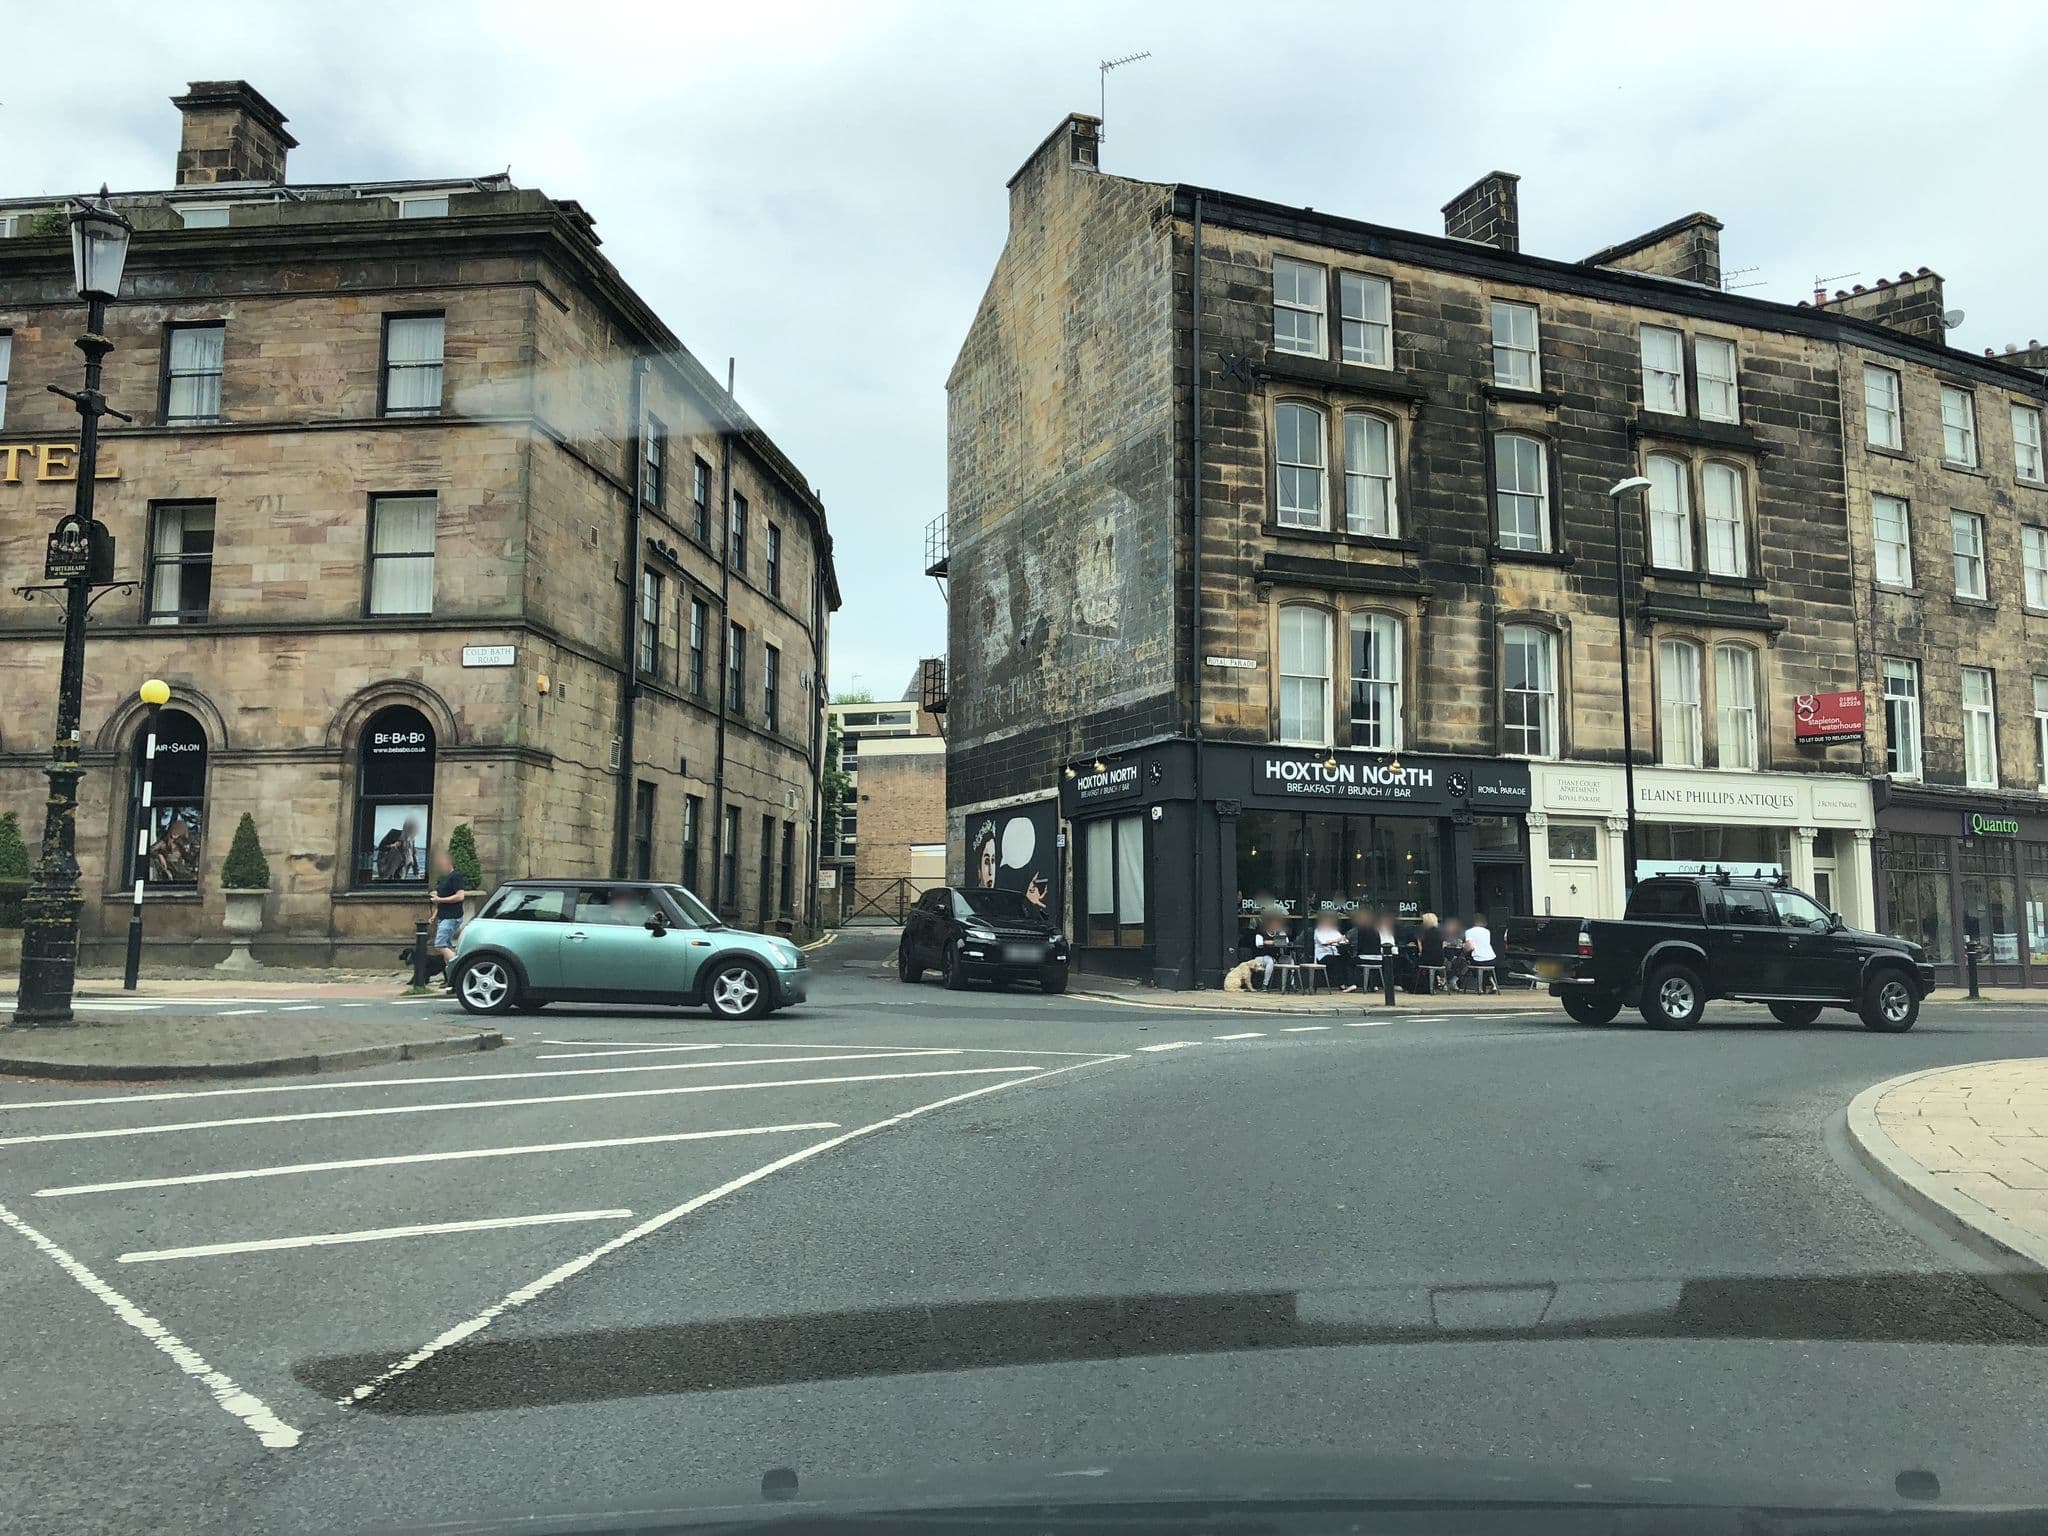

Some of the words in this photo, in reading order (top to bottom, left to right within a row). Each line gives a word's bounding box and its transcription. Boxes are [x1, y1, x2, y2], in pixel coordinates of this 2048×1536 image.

[490, 648, 511, 656] BATH
[478, 656, 500, 664] ROAD
[1808, 716, 1840, 729] stapleton
[1821, 721, 1862, 731] waterhouse
[1077, 772, 1108, 790] HOXTON
[1110, 766, 1137, 783] NORTH
[1266, 760, 1354, 783] HOXTON
[1363, 766, 1433, 787] NORTH
[1122, 783, 1130, 791] BAR
[1287, 783, 1336, 794] BREAKFAST
[1348, 786, 1382, 797] BRUNCH
[1394, 789, 1411, 798] BAR
[1477, 786, 1498, 794] ROYAL
[1500, 787, 1526, 795] PARADE
[1641, 788, 1682, 802] ELAINE
[1686, 791, 1735, 805] PHILLIPS
[1737, 794, 1794, 809] ANTIQUES
[1972, 813, 2019, 835] Quantro
[1242, 899, 1296, 910] BREFAST
[1399, 902, 1418, 912] BAR
